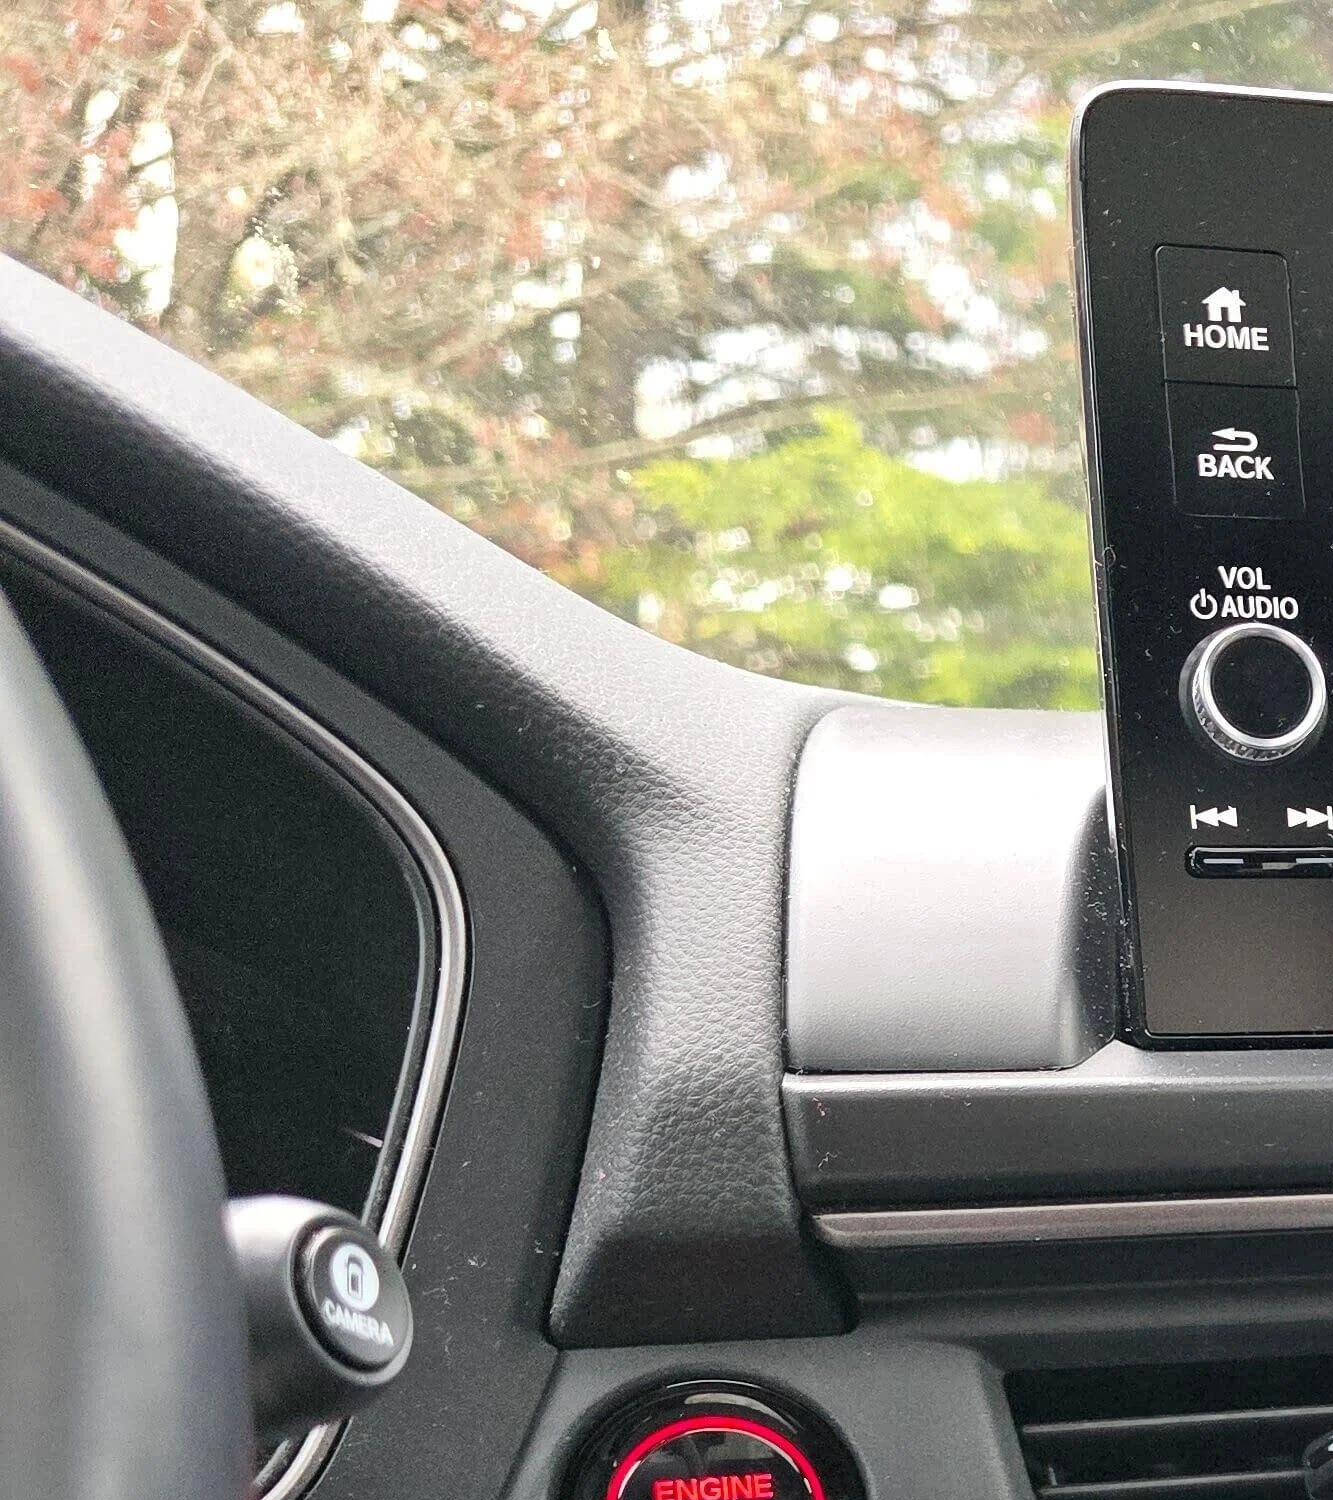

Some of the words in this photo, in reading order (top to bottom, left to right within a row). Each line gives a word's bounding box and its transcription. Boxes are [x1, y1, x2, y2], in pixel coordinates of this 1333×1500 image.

[1182, 322, 1270, 352] HOME
[1197, 451, 1275, 482] BACK
[1217, 565, 1272, 593] VOL
[1220, 594, 1300, 620] AUDIO
[321, 1295, 394, 1346] CAMERA
